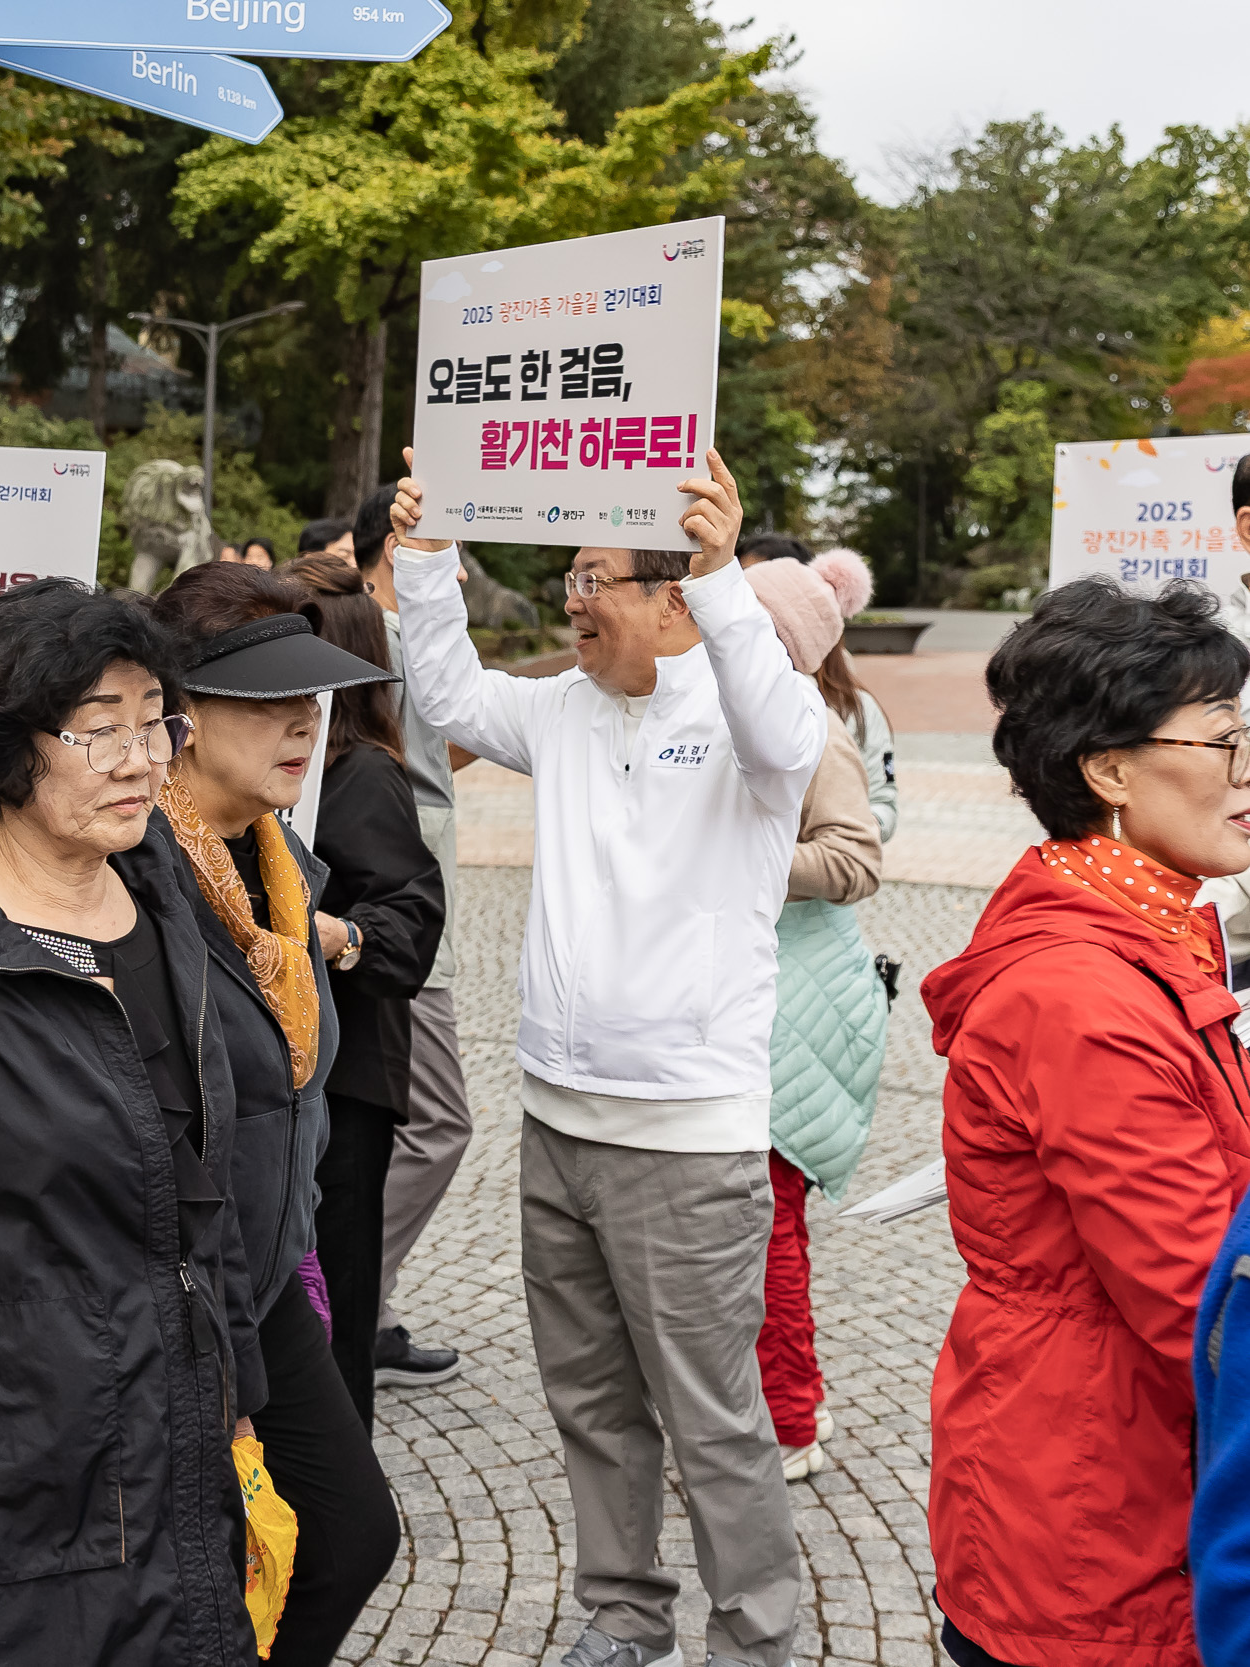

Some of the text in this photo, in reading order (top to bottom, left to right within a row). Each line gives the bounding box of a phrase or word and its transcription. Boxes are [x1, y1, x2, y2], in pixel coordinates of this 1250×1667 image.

[186, 0, 306, 33] Beijing
[353, 7, 405, 22] 954 km
[132, 50, 198, 96] Berlin
[242, 95, 257, 110] km
[462, 283, 662, 325] 2025 광진가족 가을길 걷기대회
[427, 343, 632, 404] 오늘도 한 걸음,
[480, 414, 697, 470] 활기찬 하루로!
[562, 510, 585, 520] 광진구
[1137, 502, 1192, 522] 2025
[1082, 529, 1171, 554] 광진가족
[1120, 559, 1207, 582] 걷기대회
